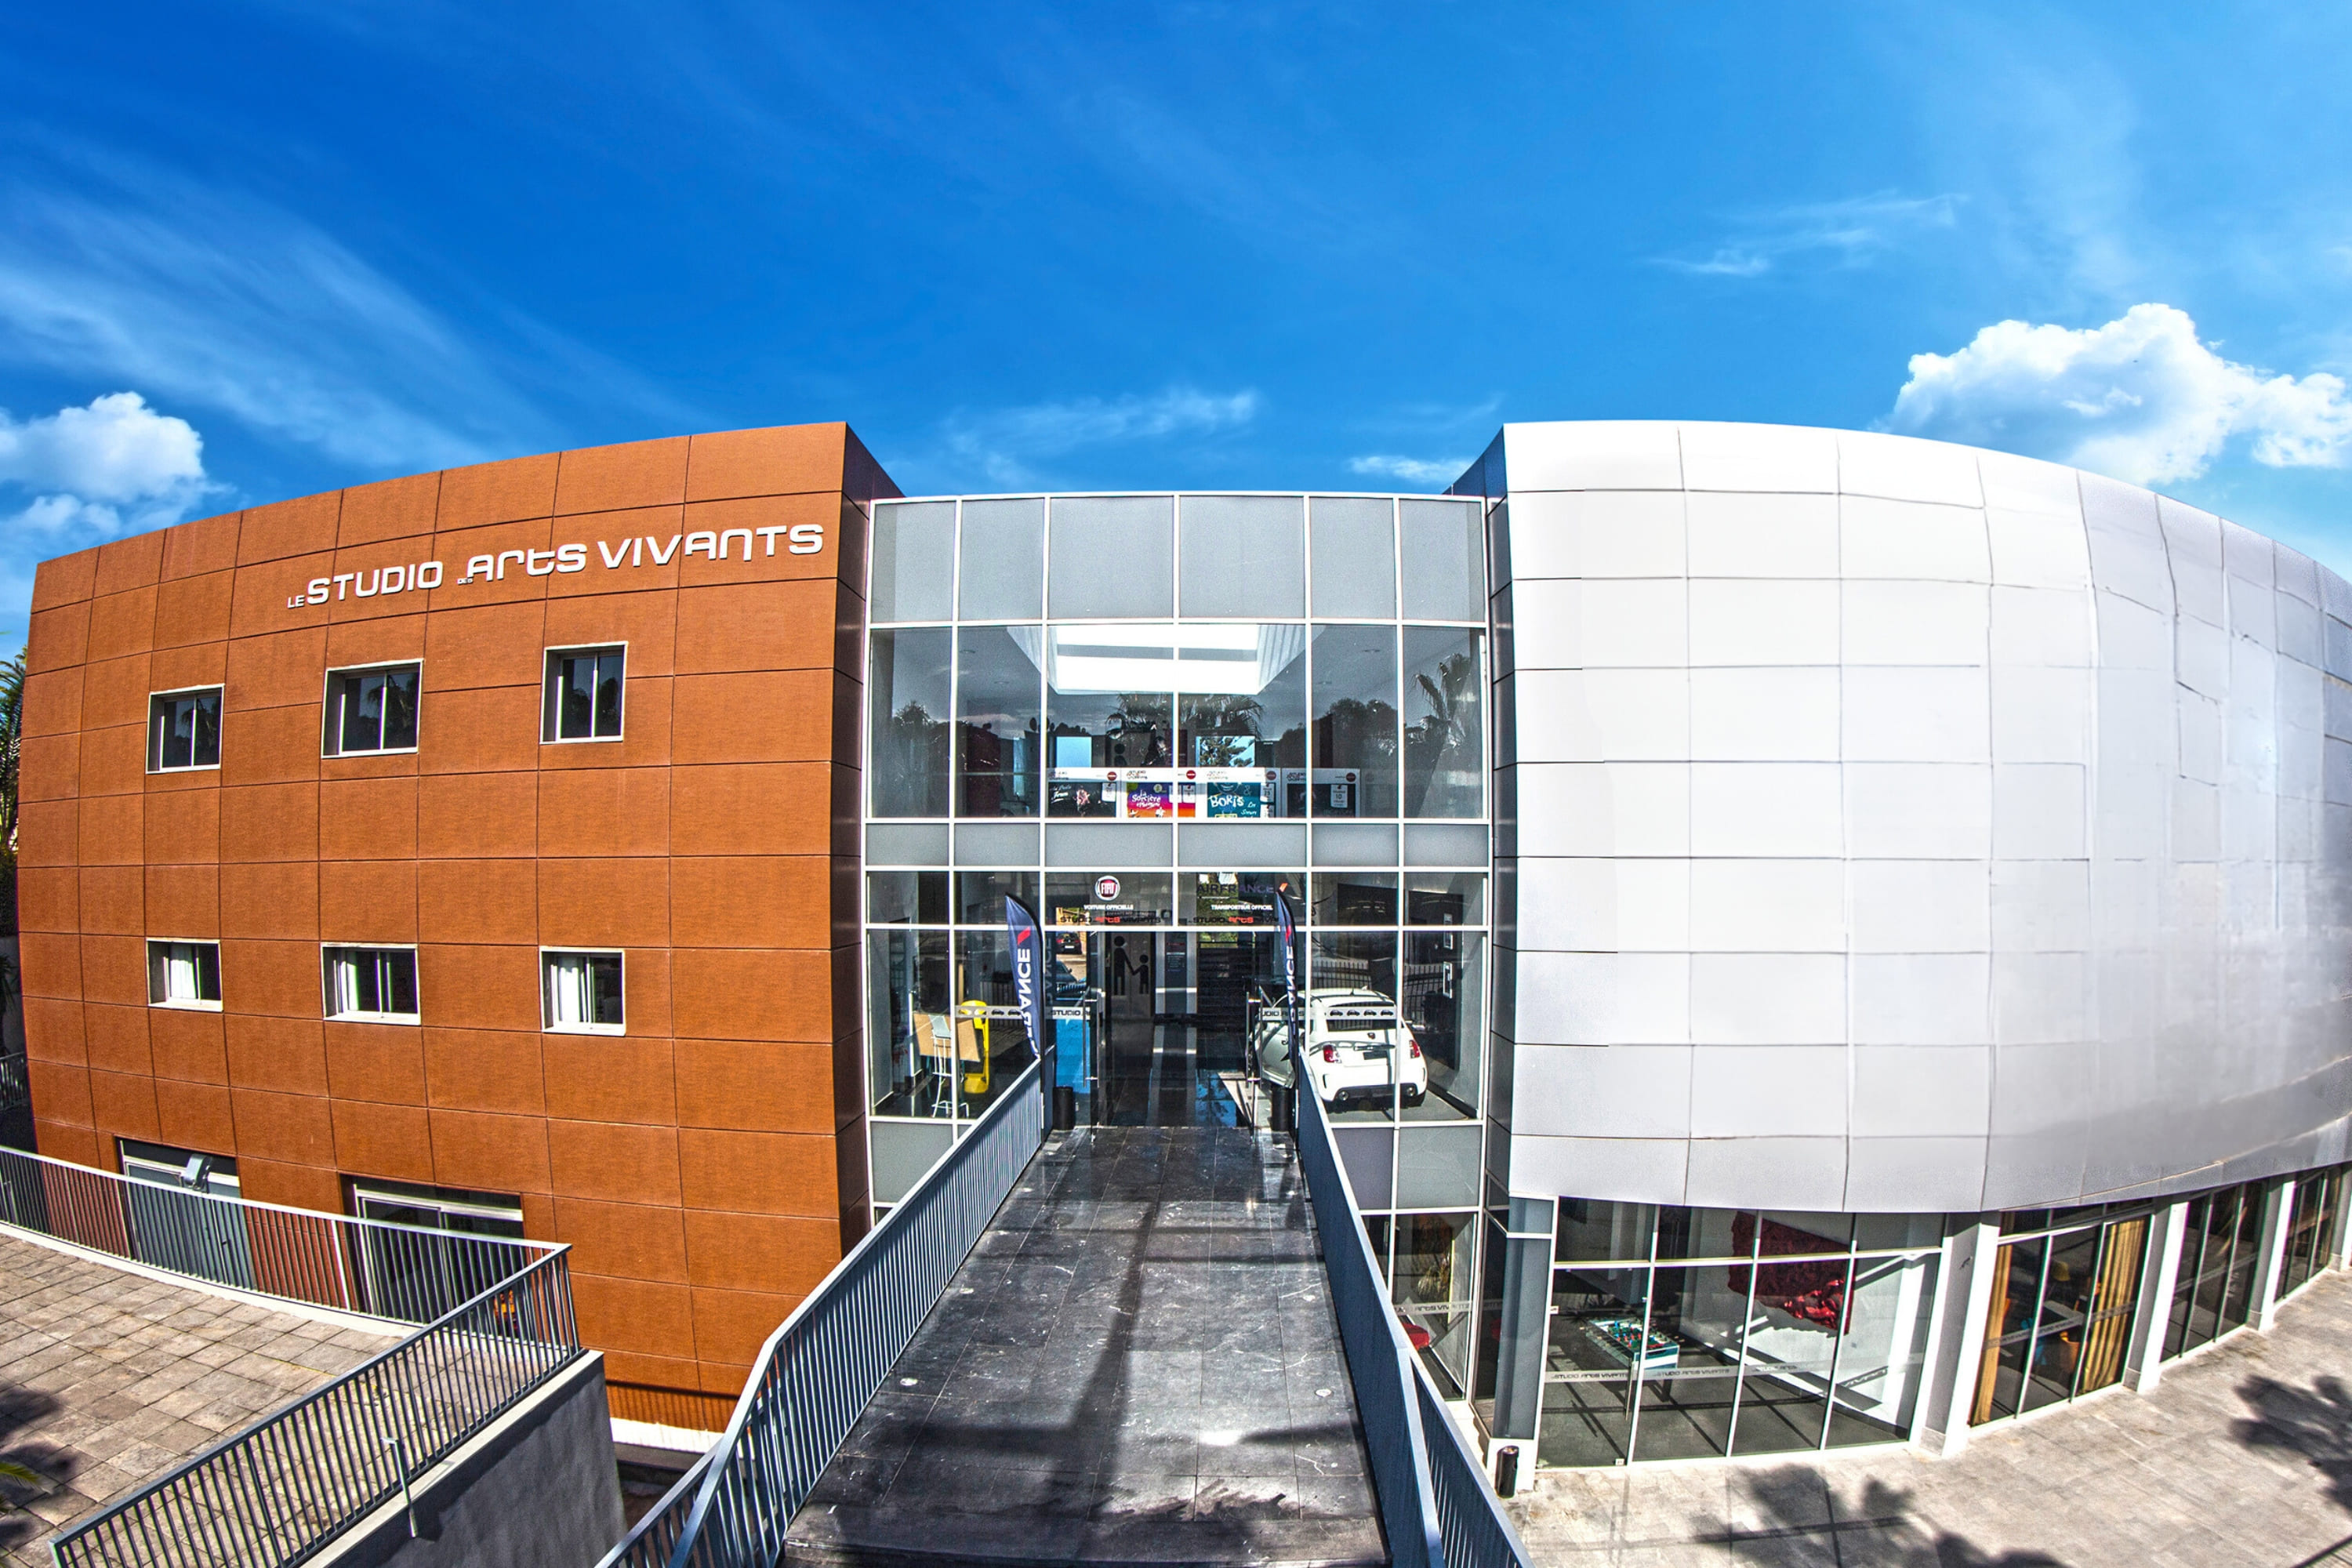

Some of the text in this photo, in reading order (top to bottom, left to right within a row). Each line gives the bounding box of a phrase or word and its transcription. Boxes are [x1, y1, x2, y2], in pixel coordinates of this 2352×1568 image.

[287, 594, 305, 608] LE
[307, 561, 444, 605] STUDIO
[597, 524, 824, 568] VIVANTS
[1101, 882, 1116, 895] FIAT
